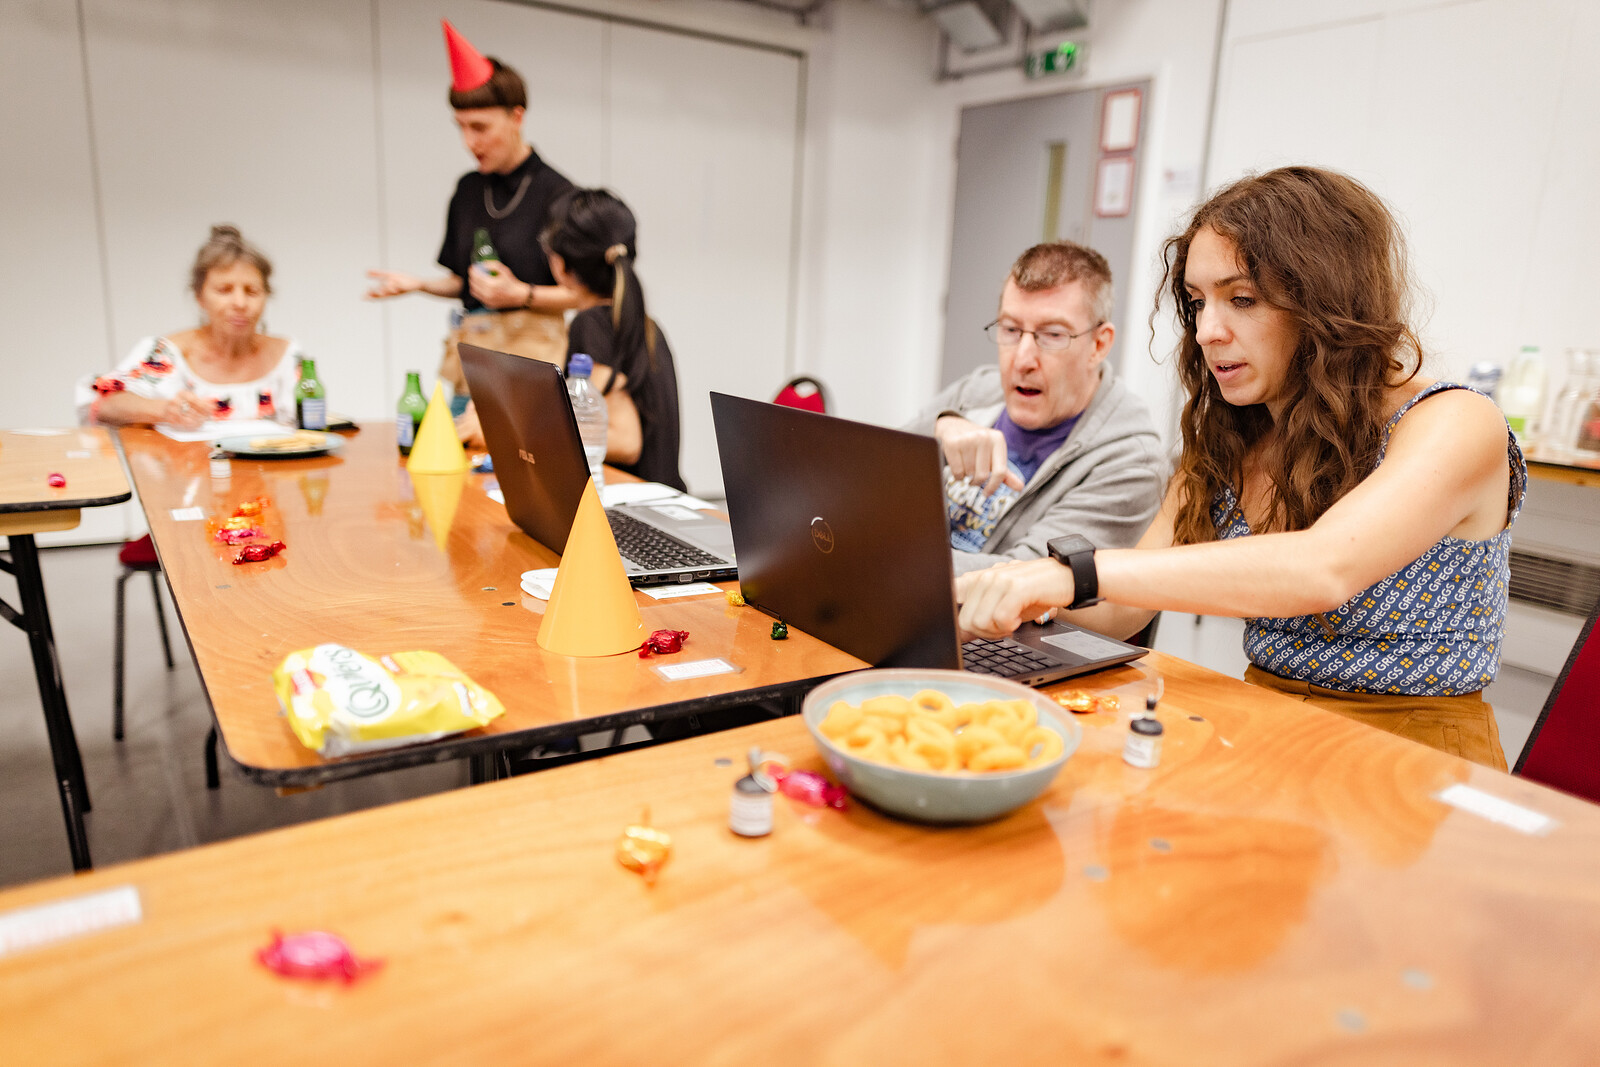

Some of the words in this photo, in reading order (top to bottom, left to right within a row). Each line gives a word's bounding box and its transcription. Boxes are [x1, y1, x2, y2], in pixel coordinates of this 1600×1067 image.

[519, 449, 535, 464] ASUS
[815, 528, 831, 542] DELL
[1429, 554, 1464, 591] GREGGS
[1398, 572, 1431, 610] GREGGS
[1366, 591, 1400, 627] GREGGS
[1253, 629, 1284, 655] GREGGS
[1288, 640, 1325, 668] GREGGS
[1375, 639, 1415, 671] GREGGS
[1339, 648, 1379, 680] GREGGS
[1400, 653, 1439, 687] GREGGS
[1456, 652, 1490, 688] GREGGS
[1422, 669, 1462, 696] REGGS
